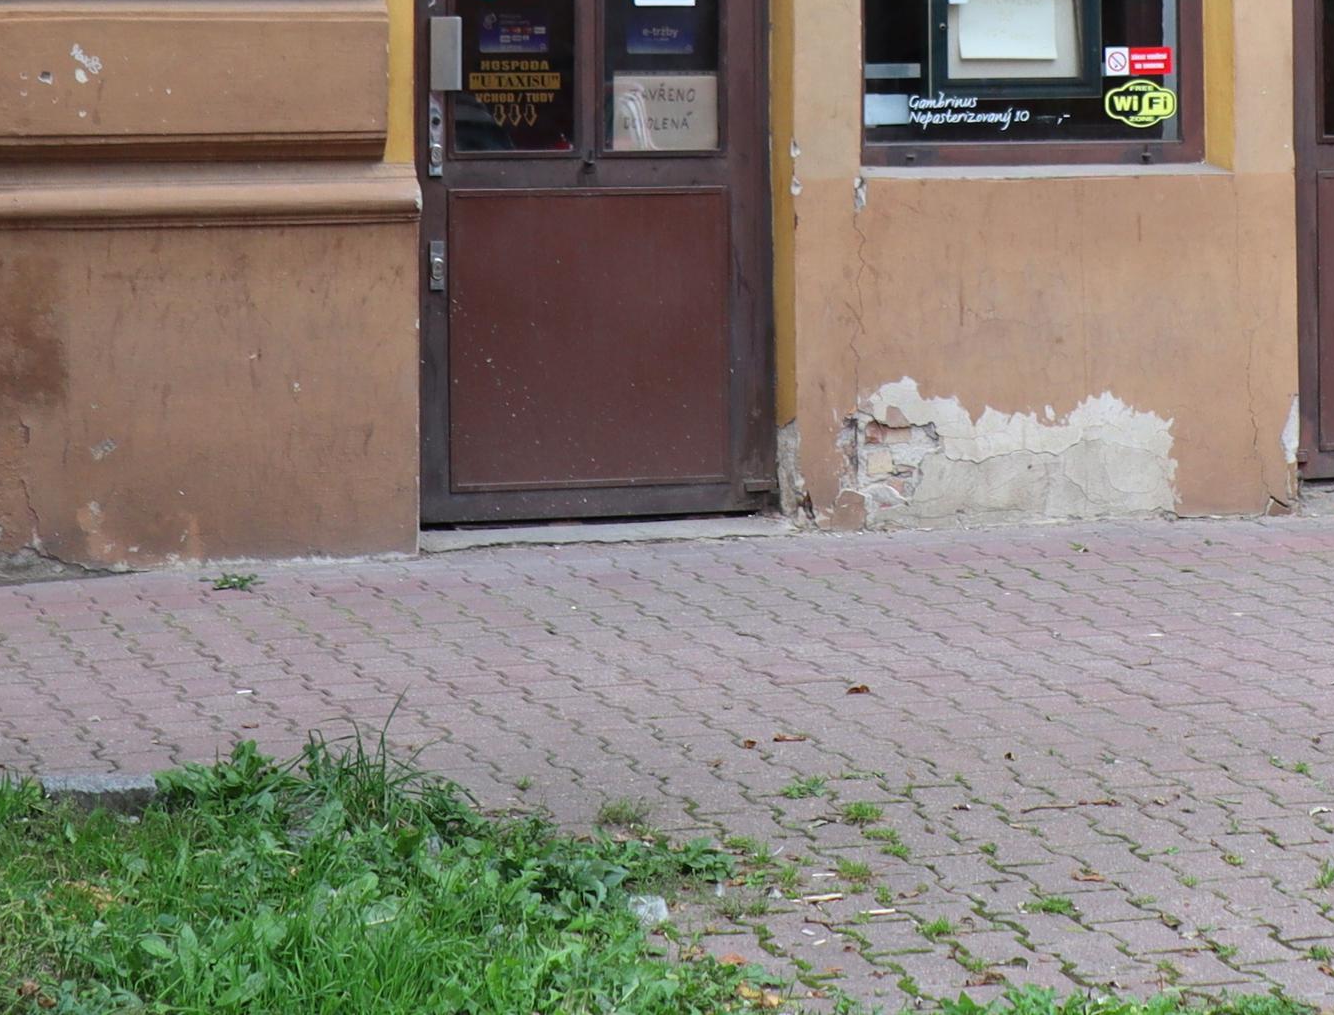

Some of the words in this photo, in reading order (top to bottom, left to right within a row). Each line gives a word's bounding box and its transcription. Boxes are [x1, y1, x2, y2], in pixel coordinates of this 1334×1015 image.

[480, 60, 550, 71] HOSPODA
[475, 92, 515, 103] VCHOD
[525, 92, 555, 103] TUDY
[908, 91, 978, 109] Gambrinus
[908, 108, 1013, 130] Nepasterizovaný
[1014, 110, 1030, 122] 10
